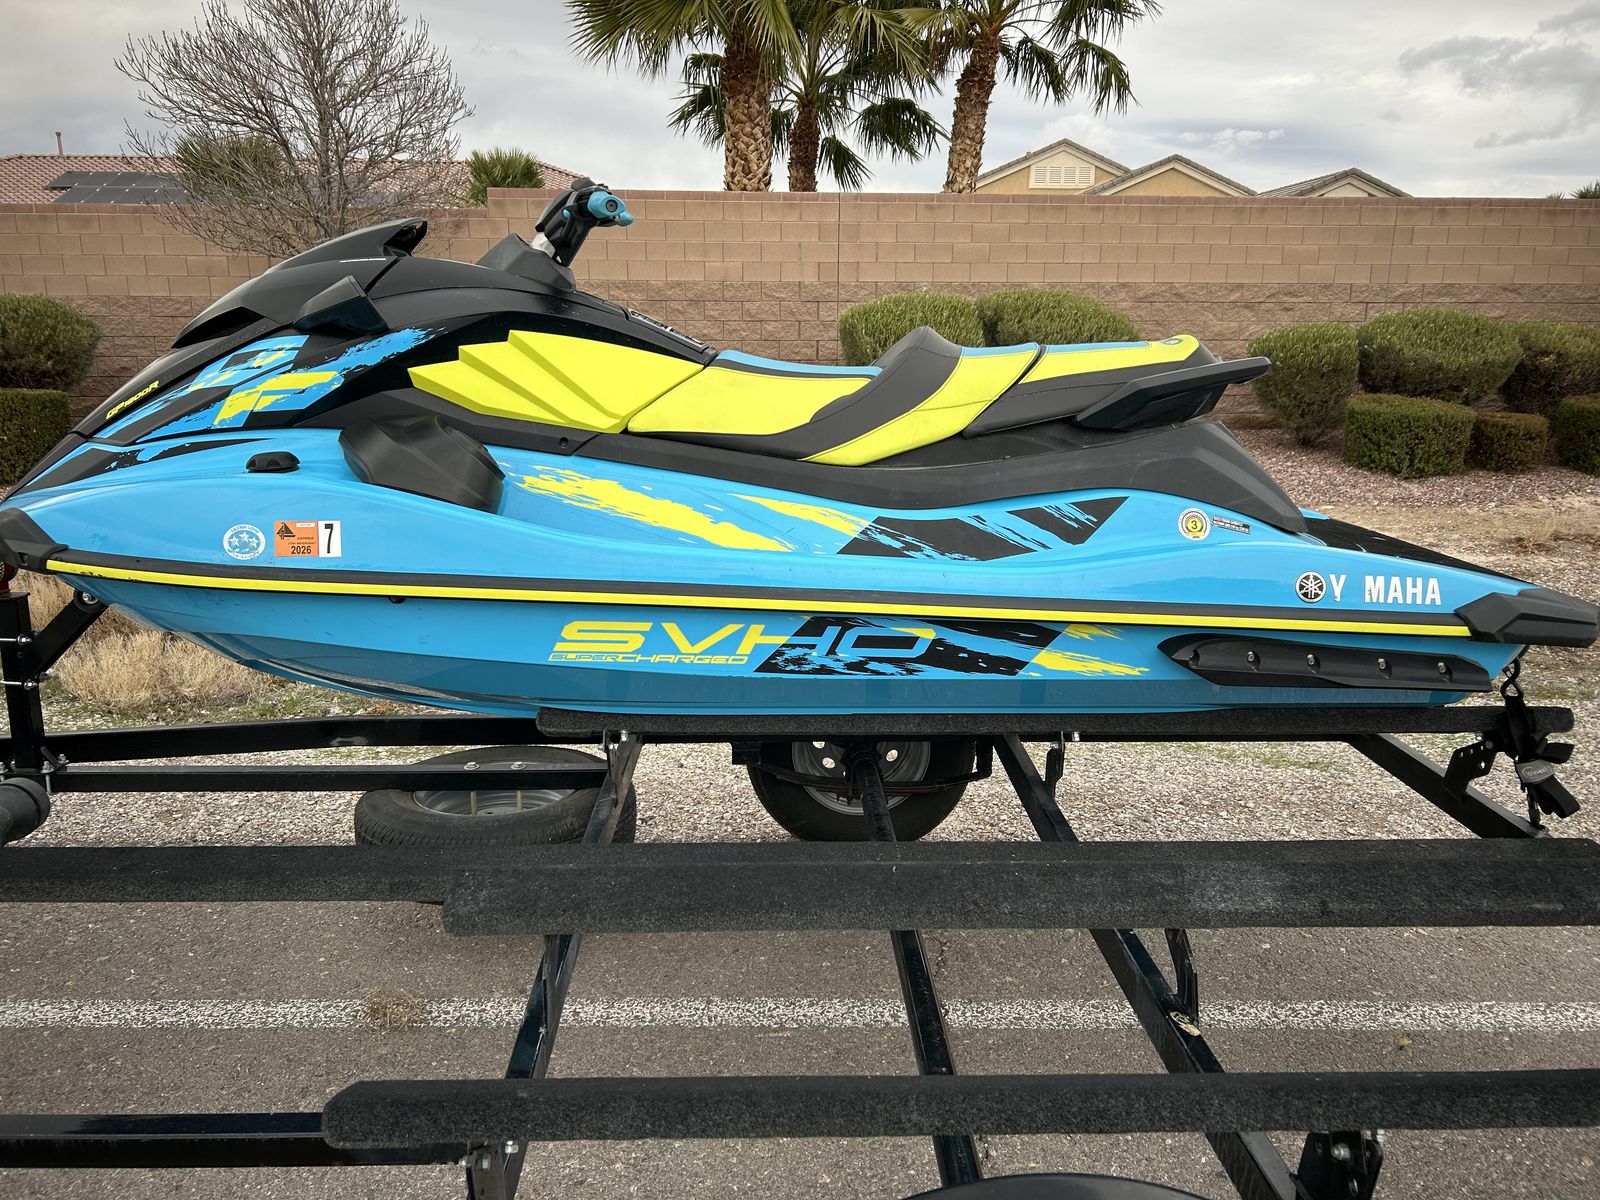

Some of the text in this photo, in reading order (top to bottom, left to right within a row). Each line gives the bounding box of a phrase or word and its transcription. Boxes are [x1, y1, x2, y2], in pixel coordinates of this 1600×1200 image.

[324, 523, 334, 554] 7
[291, 545, 312, 555] 2026
[553, 620, 937, 658] SVHO
[547, 652, 750, 666] SUPERCHARGED
